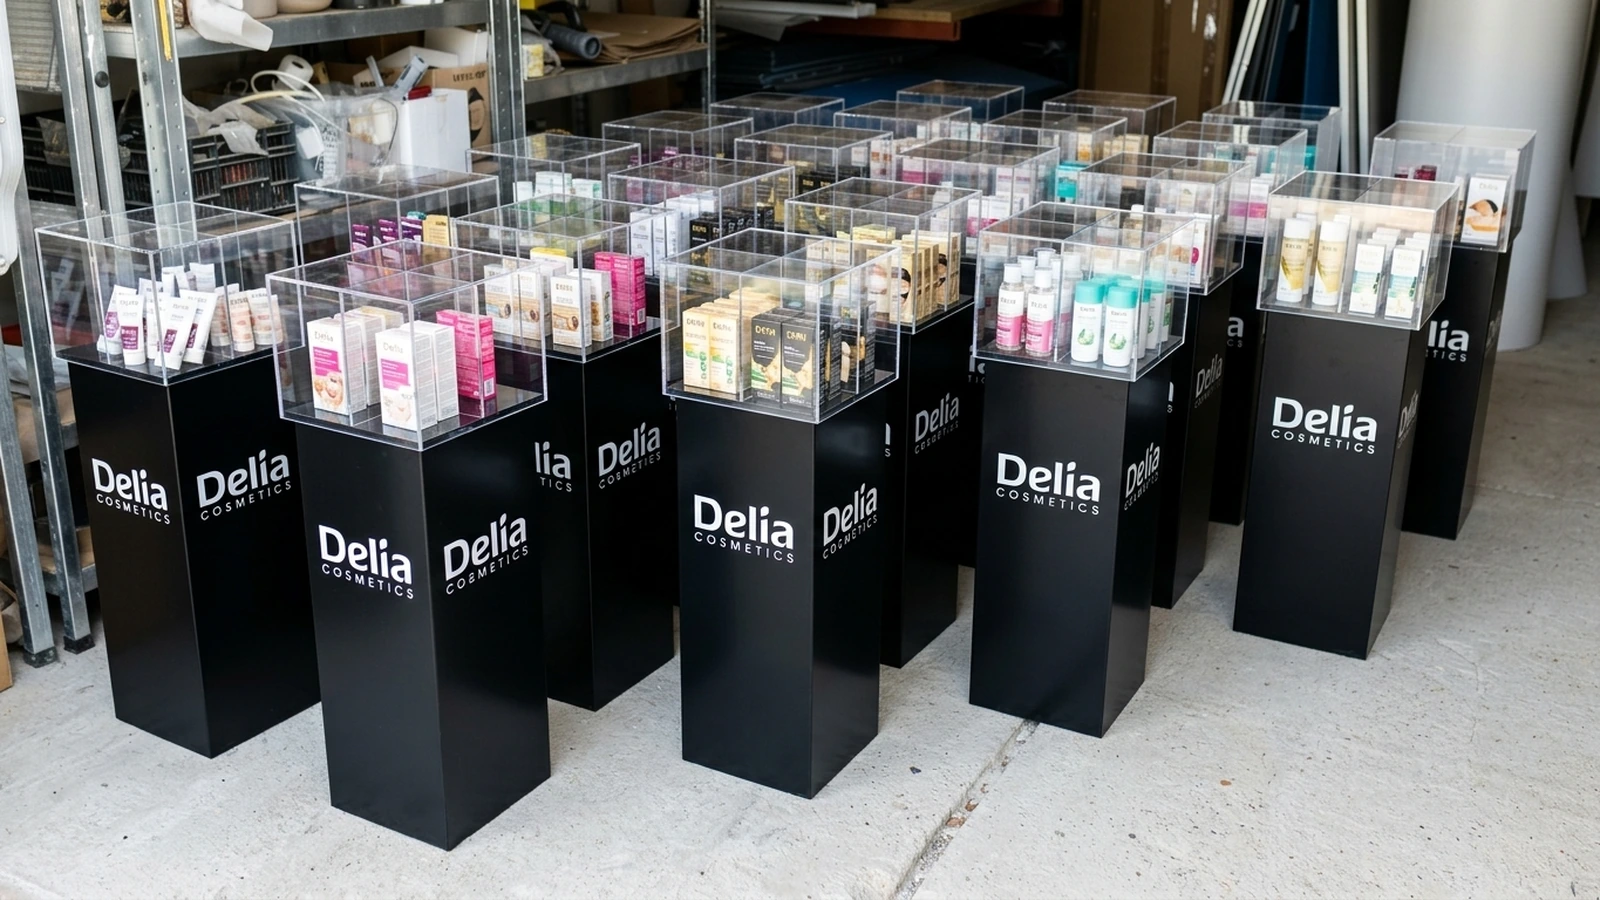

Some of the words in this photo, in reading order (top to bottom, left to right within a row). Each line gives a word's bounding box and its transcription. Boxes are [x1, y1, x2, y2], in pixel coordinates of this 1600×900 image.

[1428, 320, 1469, 351] lia
[915, 392, 960, 443] Delia
[1271, 429, 1375, 454] COSMETICS
[1272, 396, 1378, 442] Delia
[534, 441, 571, 480] lia
[598, 422, 661, 477] Delia
[1124, 442, 1161, 498] Delia
[91, 457, 168, 511] Delia
[196, 449, 290, 508] Delia
[200, 480, 292, 521] COSMETICS
[995, 487, 1100, 516] COSMETICS
[997, 452, 1101, 503] Delia
[96, 494, 170, 525] COSMETICS
[693, 494, 794, 550] Delia
[823, 482, 878, 547] Delia
[318, 524, 412, 585] Delia
[443, 513, 527, 582] Delia
[693, 531, 795, 564] COSMETICS
[321, 563, 414, 600] COSMETICS
